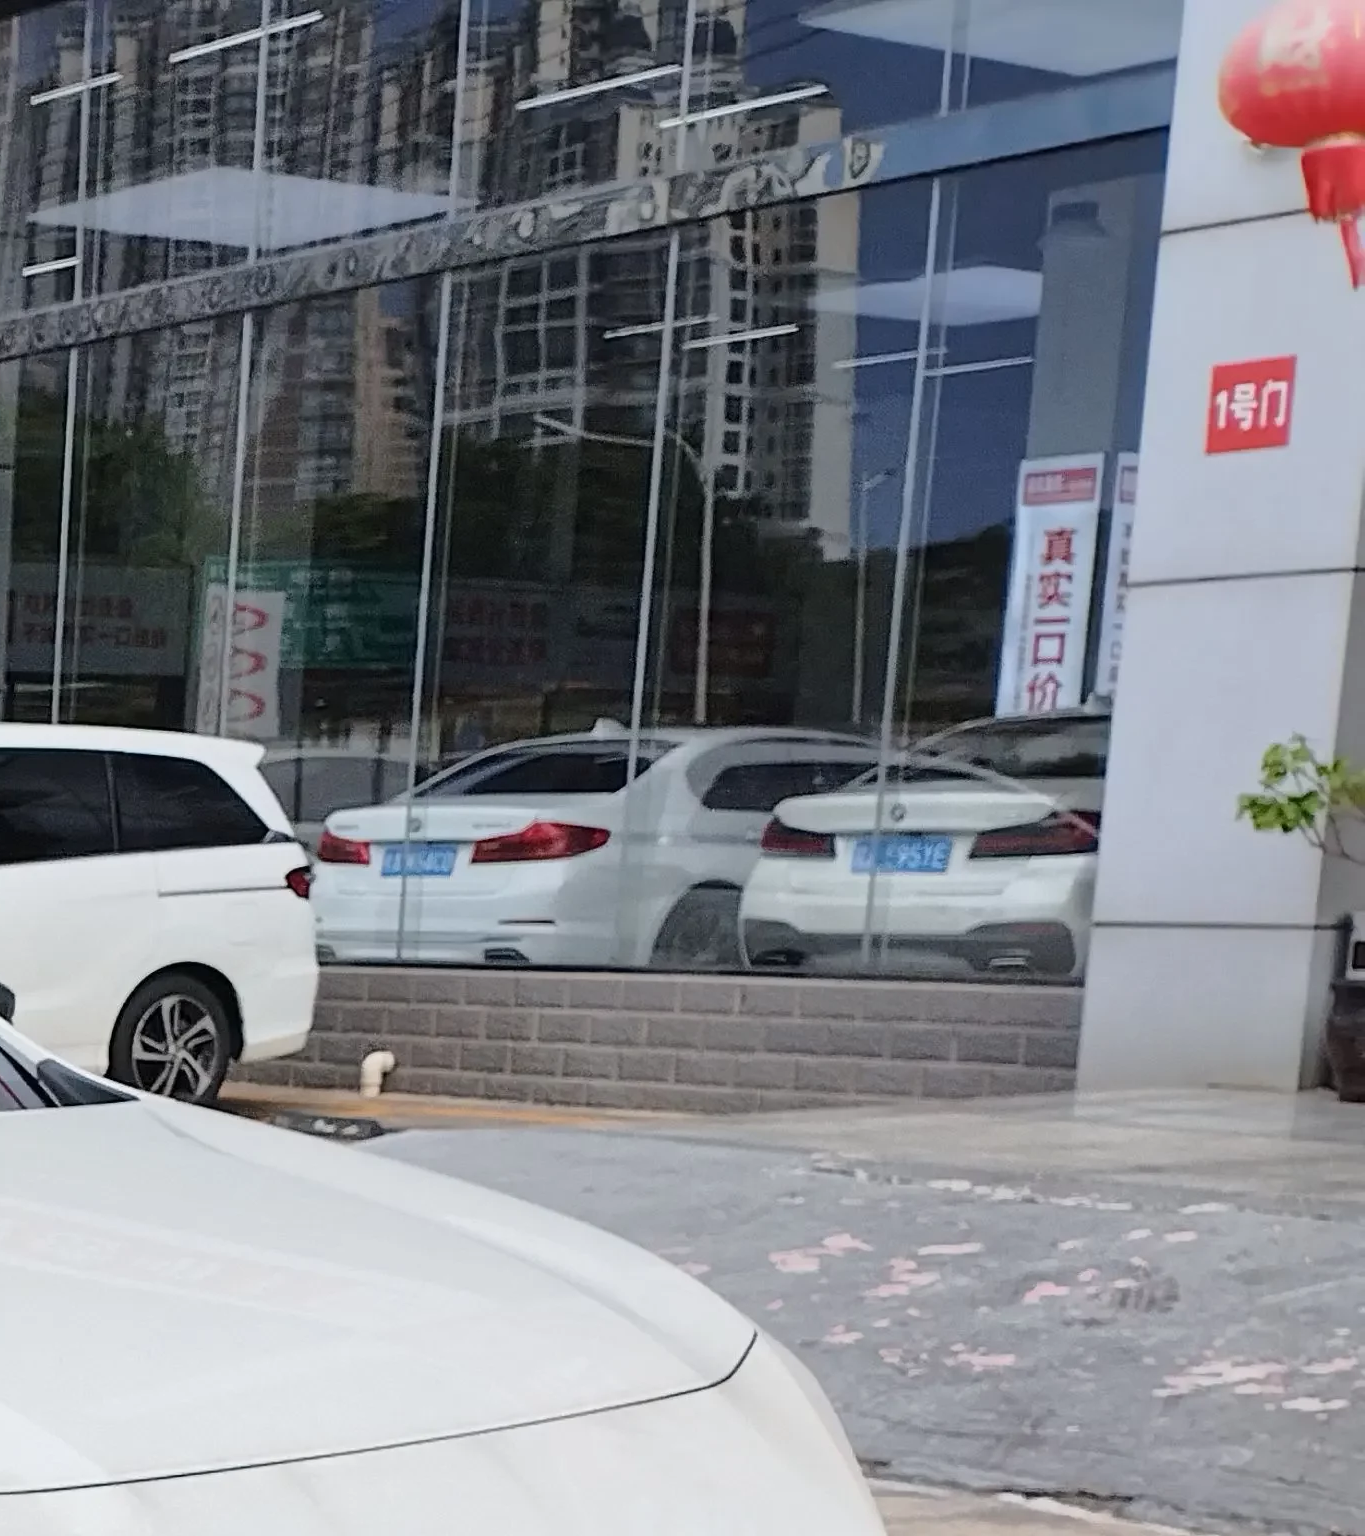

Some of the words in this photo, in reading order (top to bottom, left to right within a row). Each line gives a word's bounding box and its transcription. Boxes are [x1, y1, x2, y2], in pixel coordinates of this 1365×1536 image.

[1215, 379, 1289, 431] 1号门
[1026, 527, 1077, 713] 真实一口价
